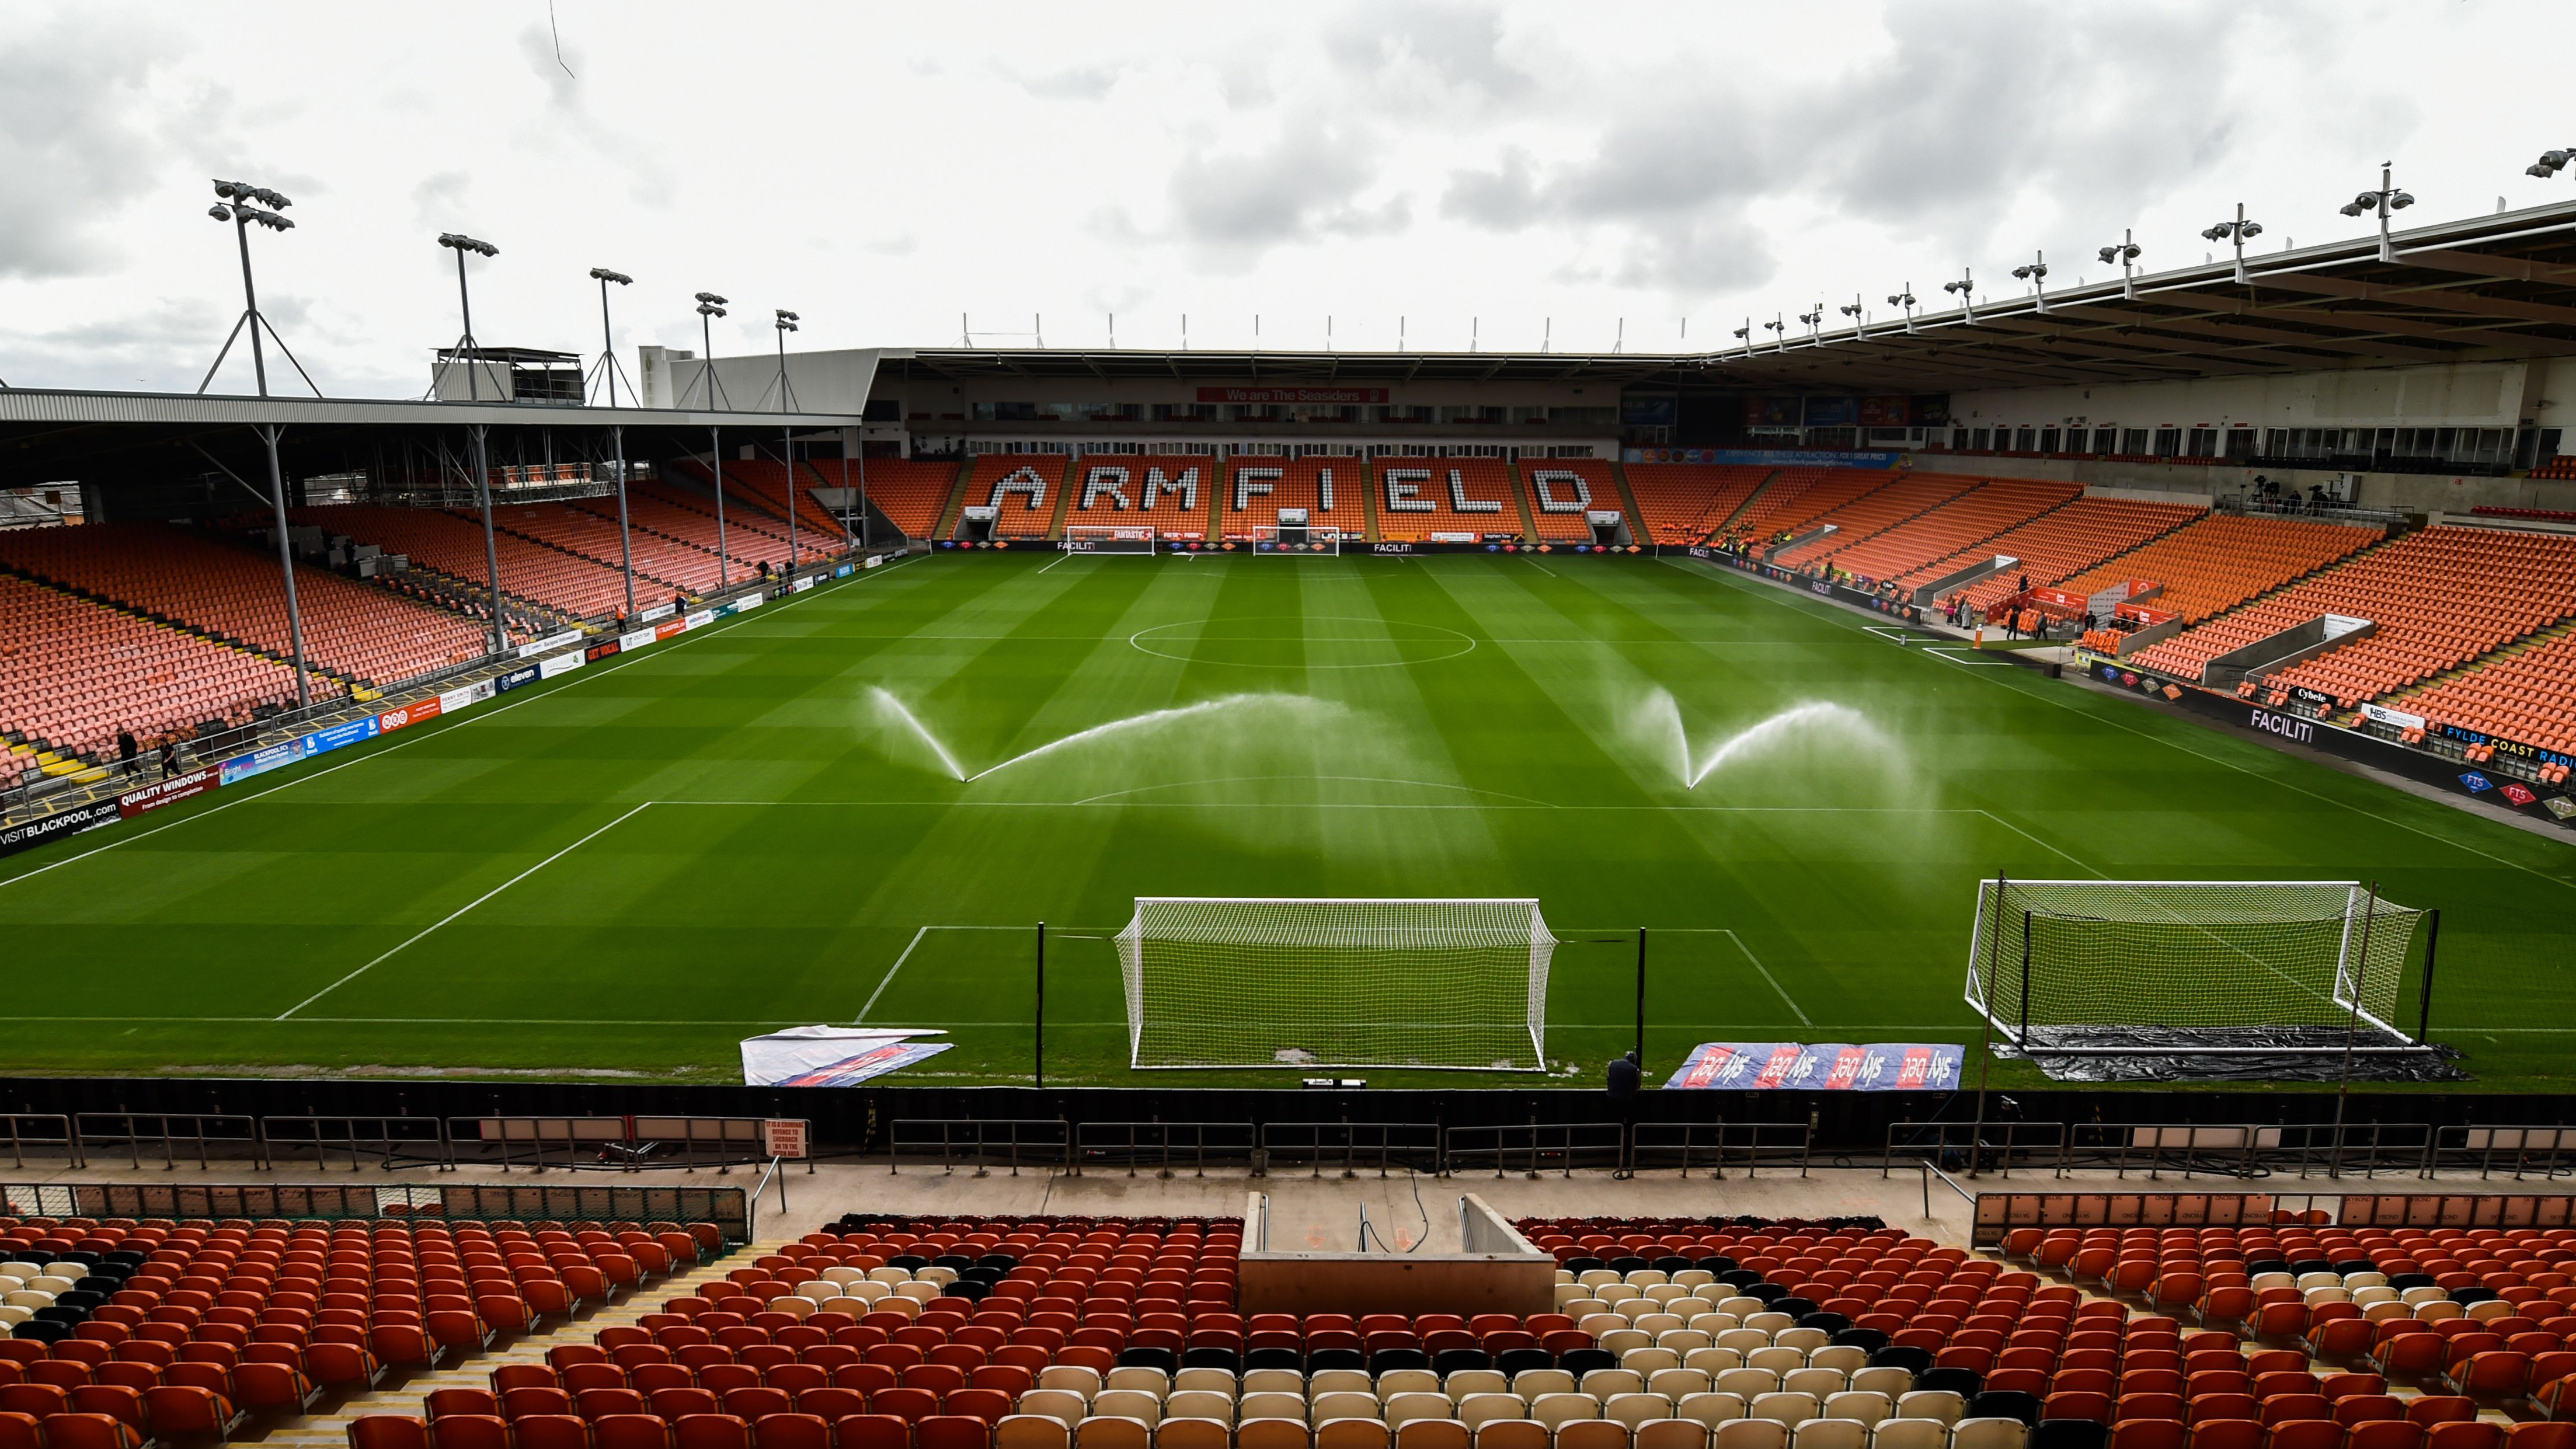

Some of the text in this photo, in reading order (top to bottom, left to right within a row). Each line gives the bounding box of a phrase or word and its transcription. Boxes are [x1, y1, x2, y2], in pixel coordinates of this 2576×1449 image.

[1226, 389, 1360, 401] We are The Seasiders
[588, 649, 598, 660] GET
[600, 642, 619, 656] VOCAL
[510, 670, 534, 683] eleven
[2297, 688, 2326, 703] Cybele
[2370, 708, 2387, 720] HBS
[2447, 727, 2486, 745] FYLDE
[2491, 739, 2534, 758] COAST
[254, 747, 280, 760] BLACKPOOL
[121, 771, 207, 806] QUALITY WINDOWS
[2467, 775, 2484, 787] FTS
[142, 802, 155, 810] From
[155, 796, 172, 806] design
[177, 786, 204, 797] completion
[2509, 787, 2526, 799] FTS
[2553, 800, 2572, 813] FTS
[1691, 1050, 1751, 1086] sky bet
[1762, 1049, 1818, 1086] sky bet
[1832, 1050, 1885, 1086] sky bet
[1901, 1050, 1952, 1086] sky bet
